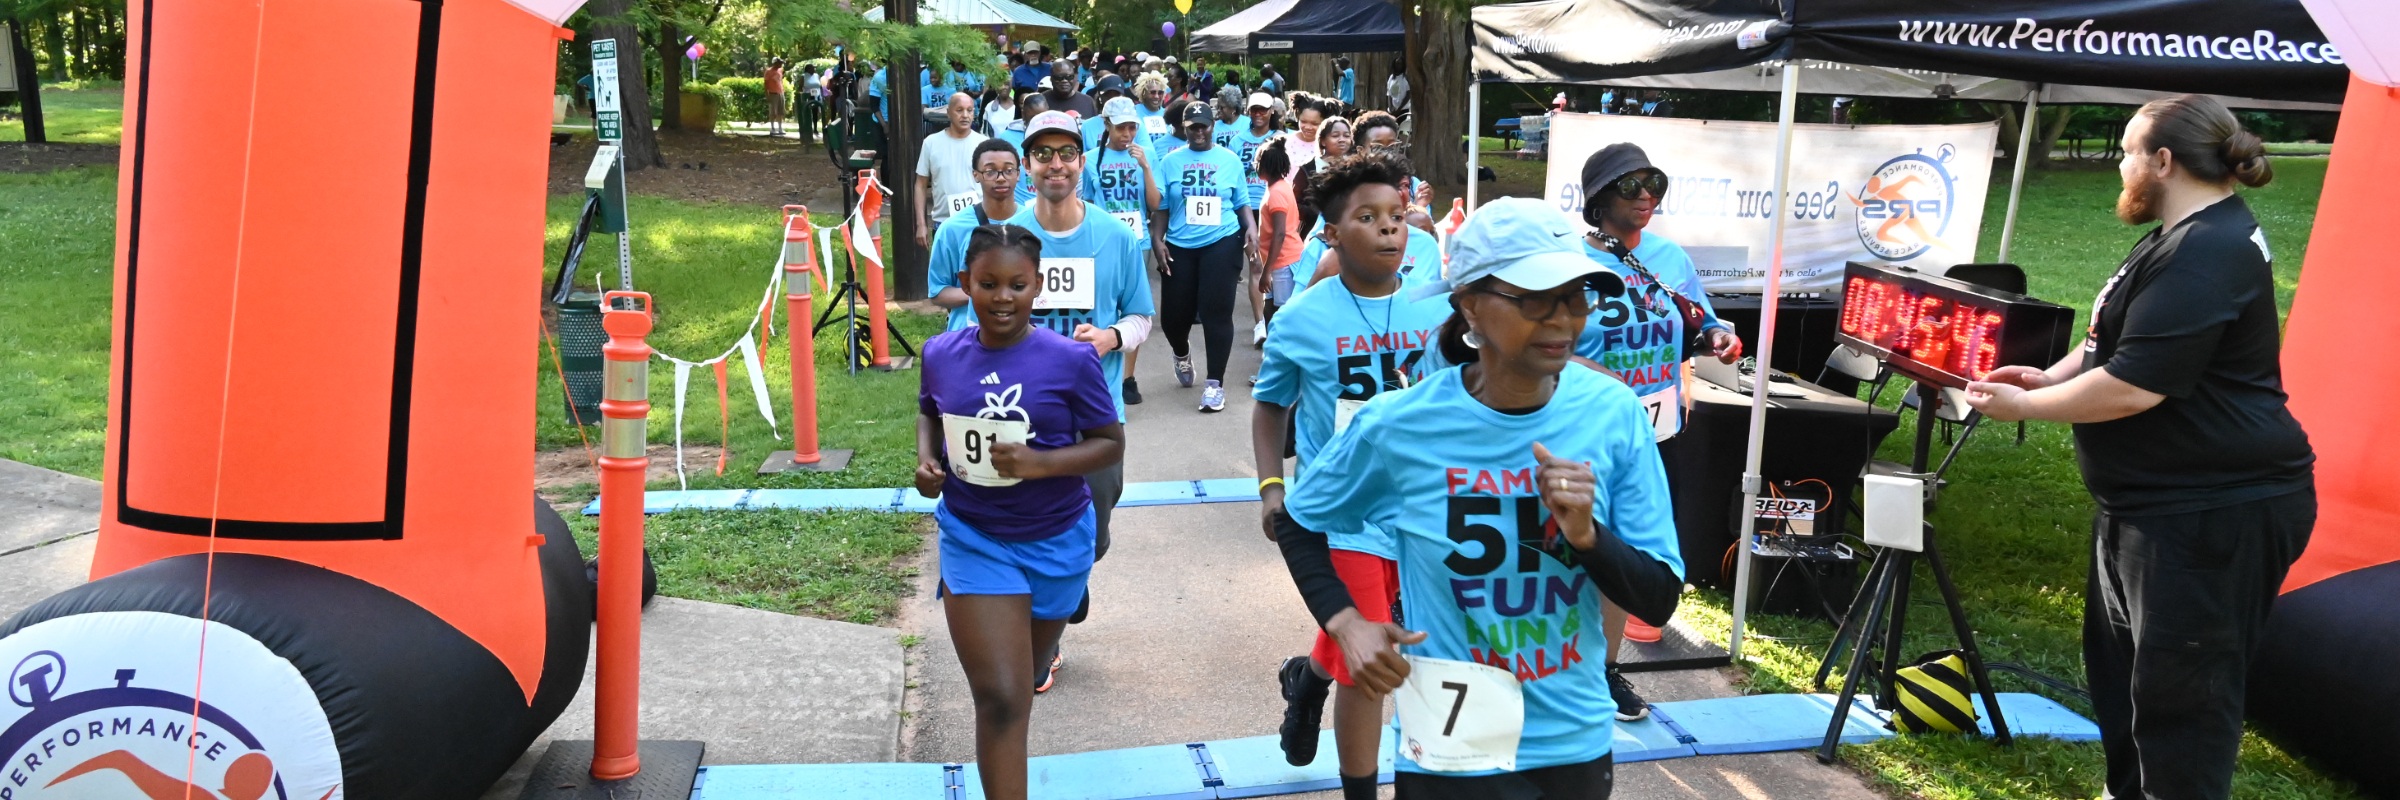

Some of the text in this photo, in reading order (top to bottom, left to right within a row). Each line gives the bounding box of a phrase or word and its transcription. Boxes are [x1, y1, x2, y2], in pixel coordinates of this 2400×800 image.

[1100, 169, 1139, 189] 5K
[1180, 169, 1217, 187] 5K
[1183, 163, 1219, 171] FAMILY
[1102, 188, 1139, 201] FUN
[1196, 201, 1211, 217] 61
[1047, 266, 1075, 293] 69
[1336, 329, 1429, 356] FAMILY
[1602, 319, 1674, 351] FUN
[1603, 344, 1676, 370] RUN &
[1336, 349, 1425, 402] 5K
[1446, 460, 1592, 495] FAM
[1450, 572, 1588, 618] FUN
[1442, 680, 1468, 737] 7
[0, 717, 227, 800] PERFORMANCE
